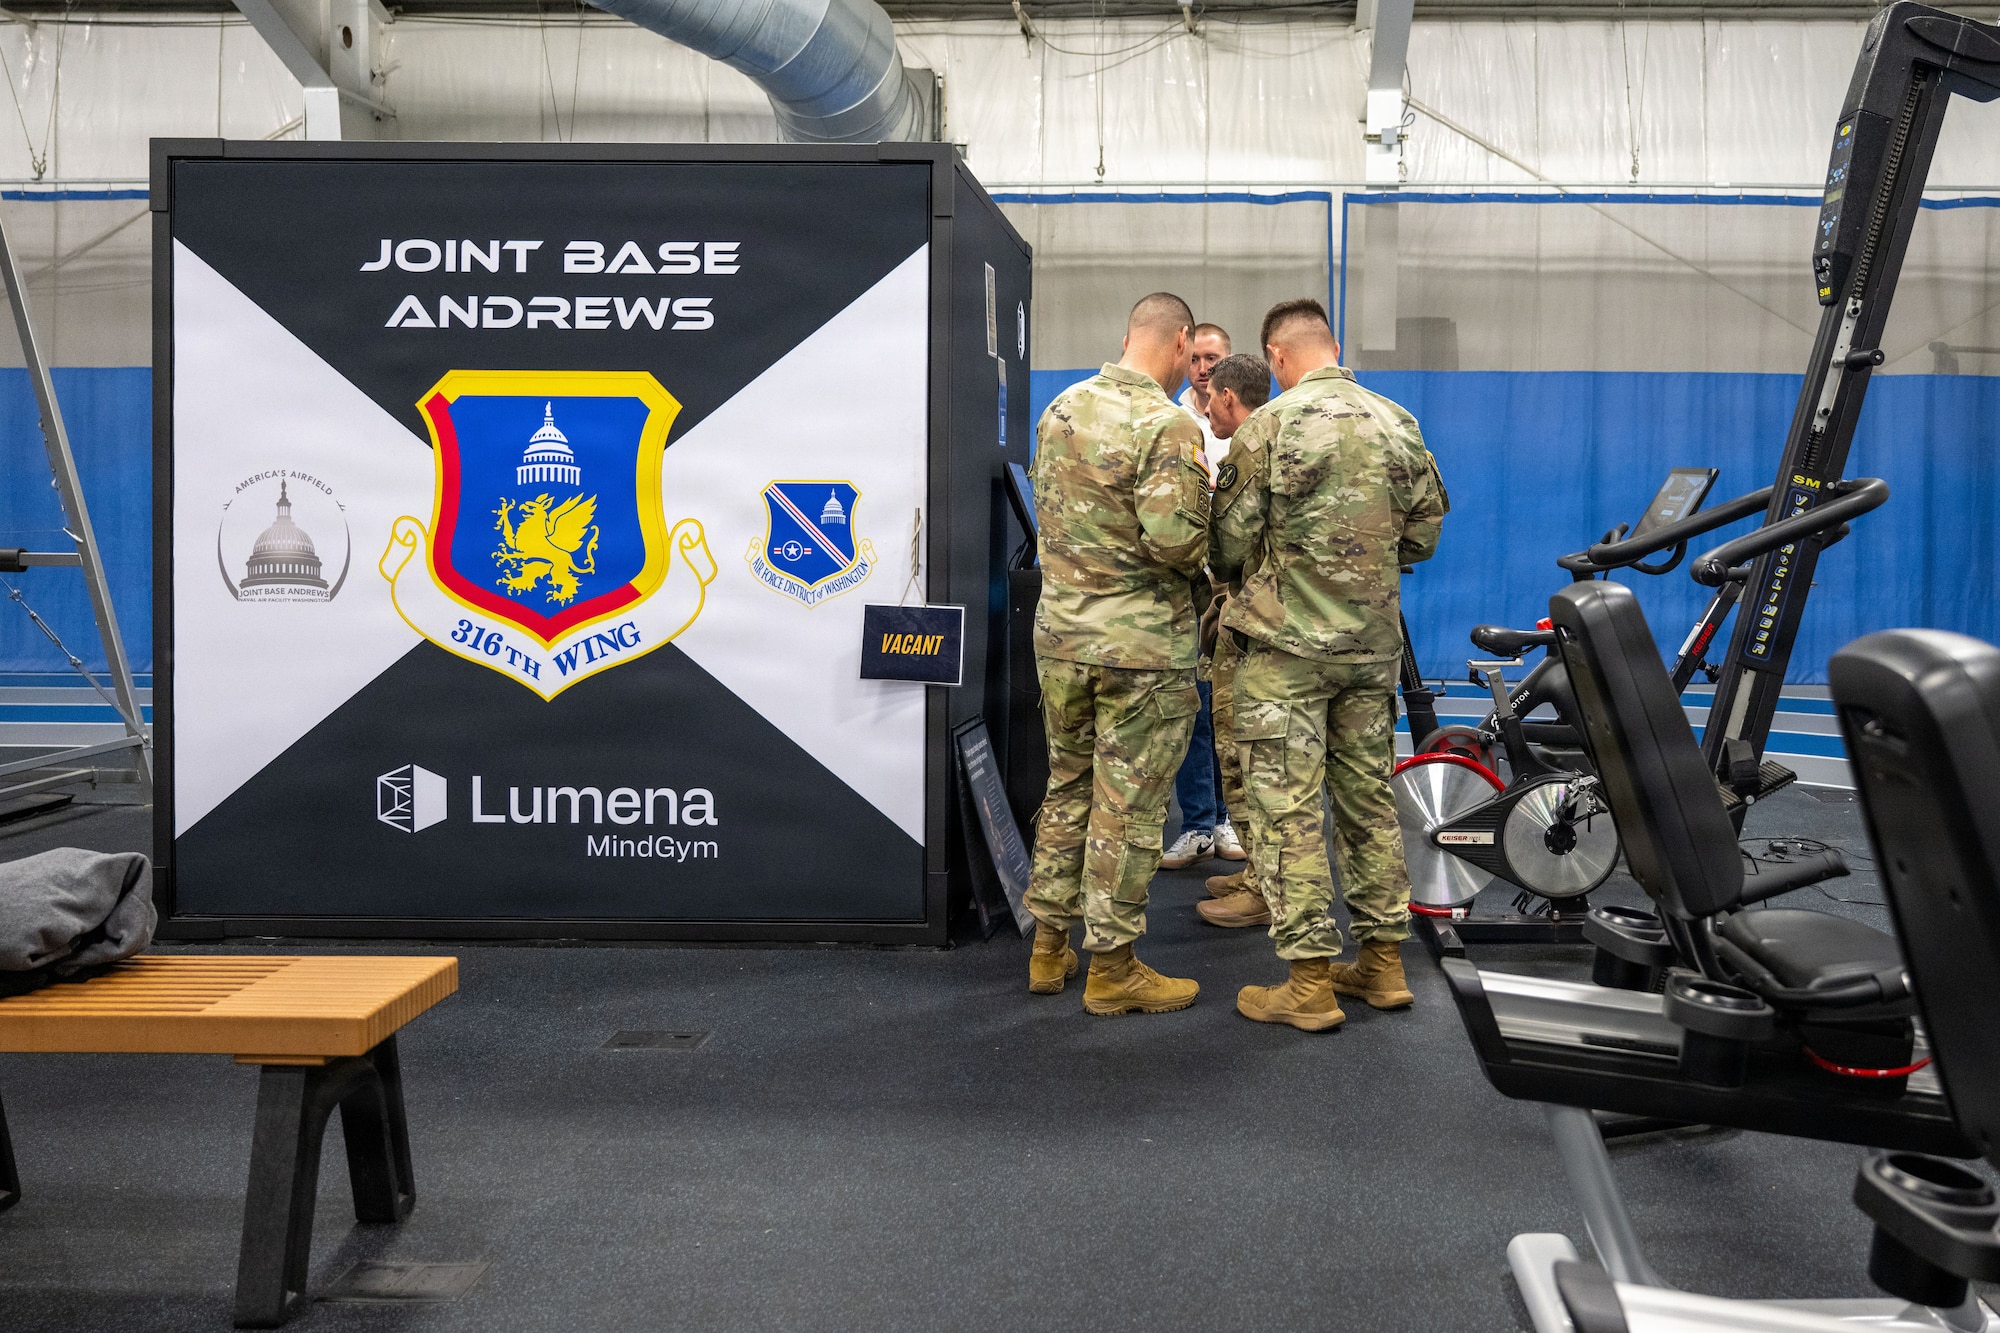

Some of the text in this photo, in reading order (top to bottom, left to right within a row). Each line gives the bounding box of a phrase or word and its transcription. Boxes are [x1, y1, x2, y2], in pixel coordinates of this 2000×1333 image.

[359, 238, 742, 275] JOINT BASE
[1819, 287, 1831, 297] SM
[384, 294, 715, 331] ANDREWS
[235, 470, 333, 496] AMERICA'S AIRFIELD
[1793, 475, 1821, 489] SM
[239, 587, 330, 598] JOINT BASE ANDREWS
[752, 556, 870, 605] AIR FORCE DISTRICT of WASHINGTON
[552, 621, 642, 677] WING
[881, 633, 945, 656] VACANT
[1692, 623, 1715, 656] KEISER
[472, 775, 719, 826] Lumena
[587, 835, 719, 863] MindGym
